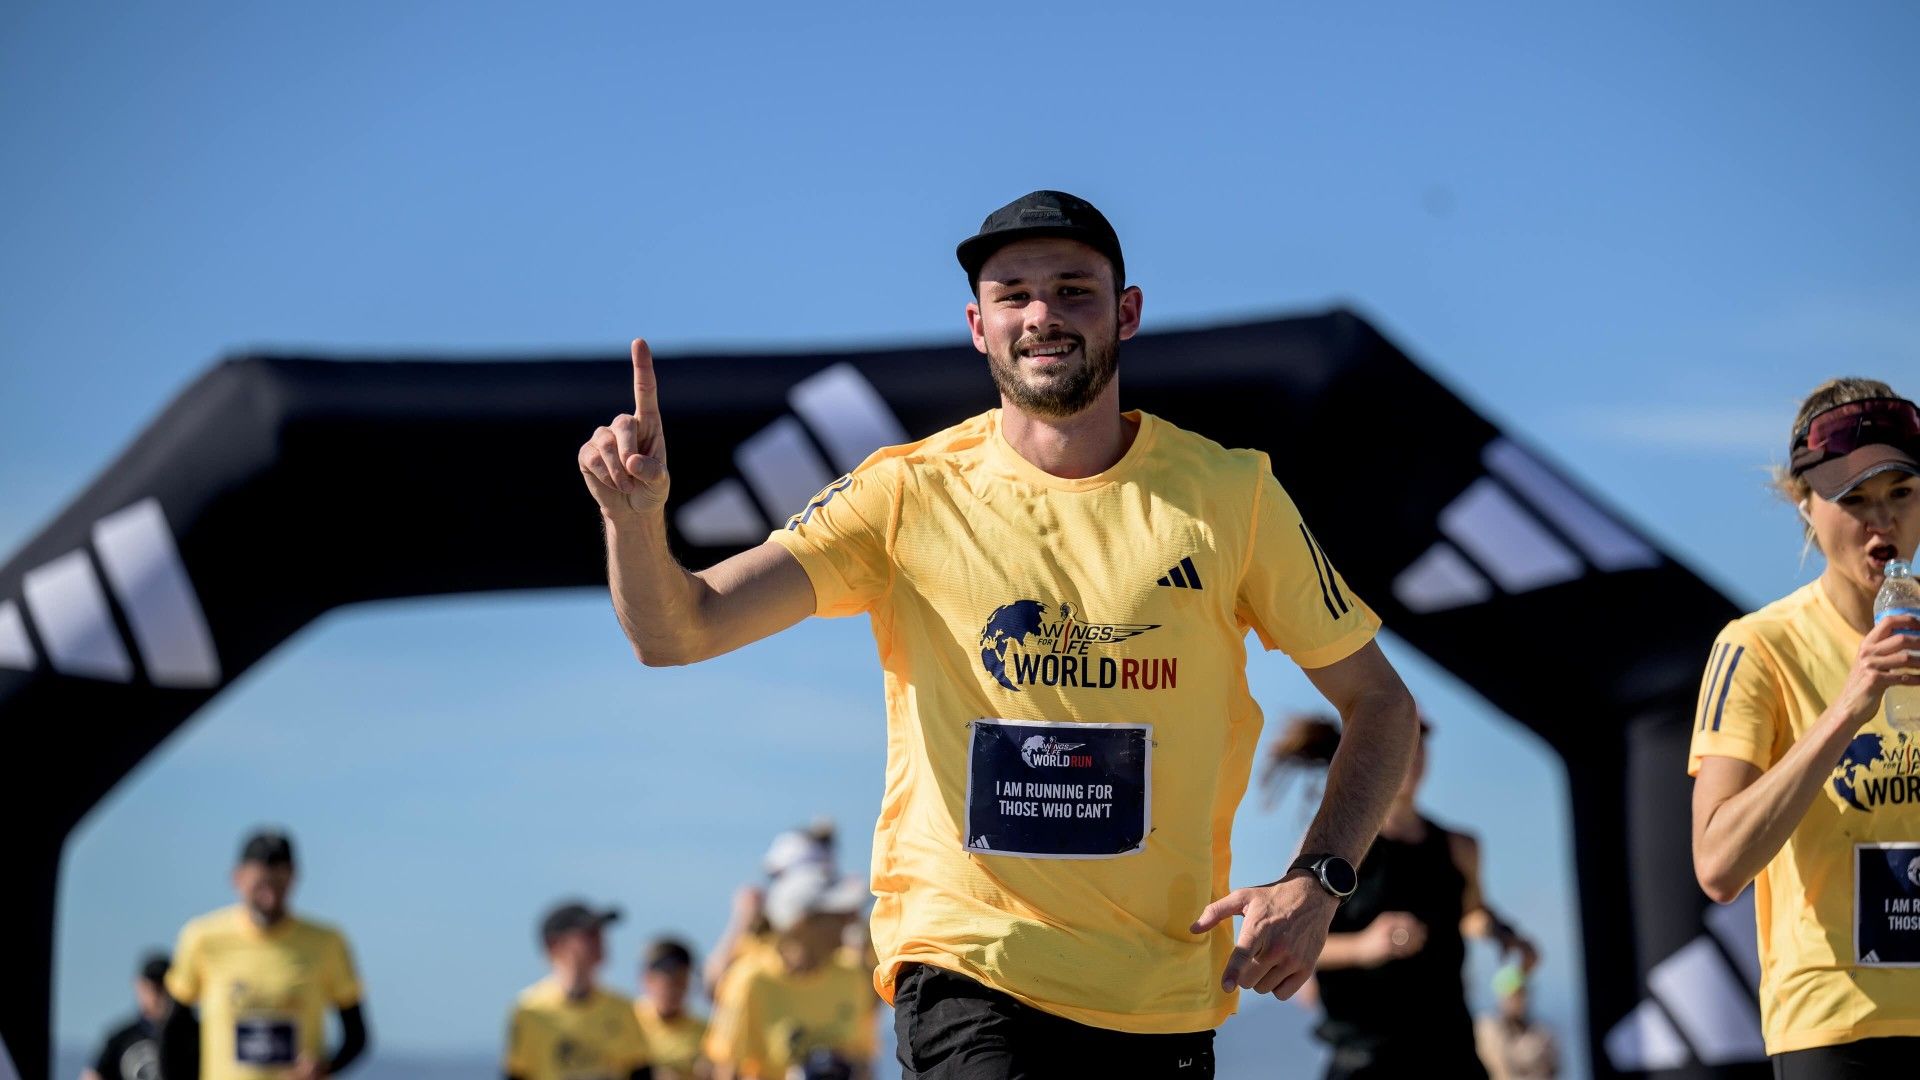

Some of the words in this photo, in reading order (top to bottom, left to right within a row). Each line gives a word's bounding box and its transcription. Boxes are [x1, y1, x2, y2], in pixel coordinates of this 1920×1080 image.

[1043, 620, 1113, 641] WINGS
[1038, 638, 1052, 646] FOR
[1051, 639, 1092, 655] LIFE
[1014, 654, 1117, 689] WORLD
[1121, 657, 1178, 690] RUN
[1033, 754, 1070, 767] WORLD
[1071, 756, 1092, 767] RUN
[997, 781, 1000, 795] I
[1003, 782, 1022, 797] AM
[1026, 783, 1084, 799] RUNNING
[1088, 784, 1113, 800] FOR
[999, 800, 1039, 817] THOSE
[1042, 802, 1072, 818] WHO
[1076, 803, 1113, 819] CAN'T
[1892, 898, 1910, 913] AM
